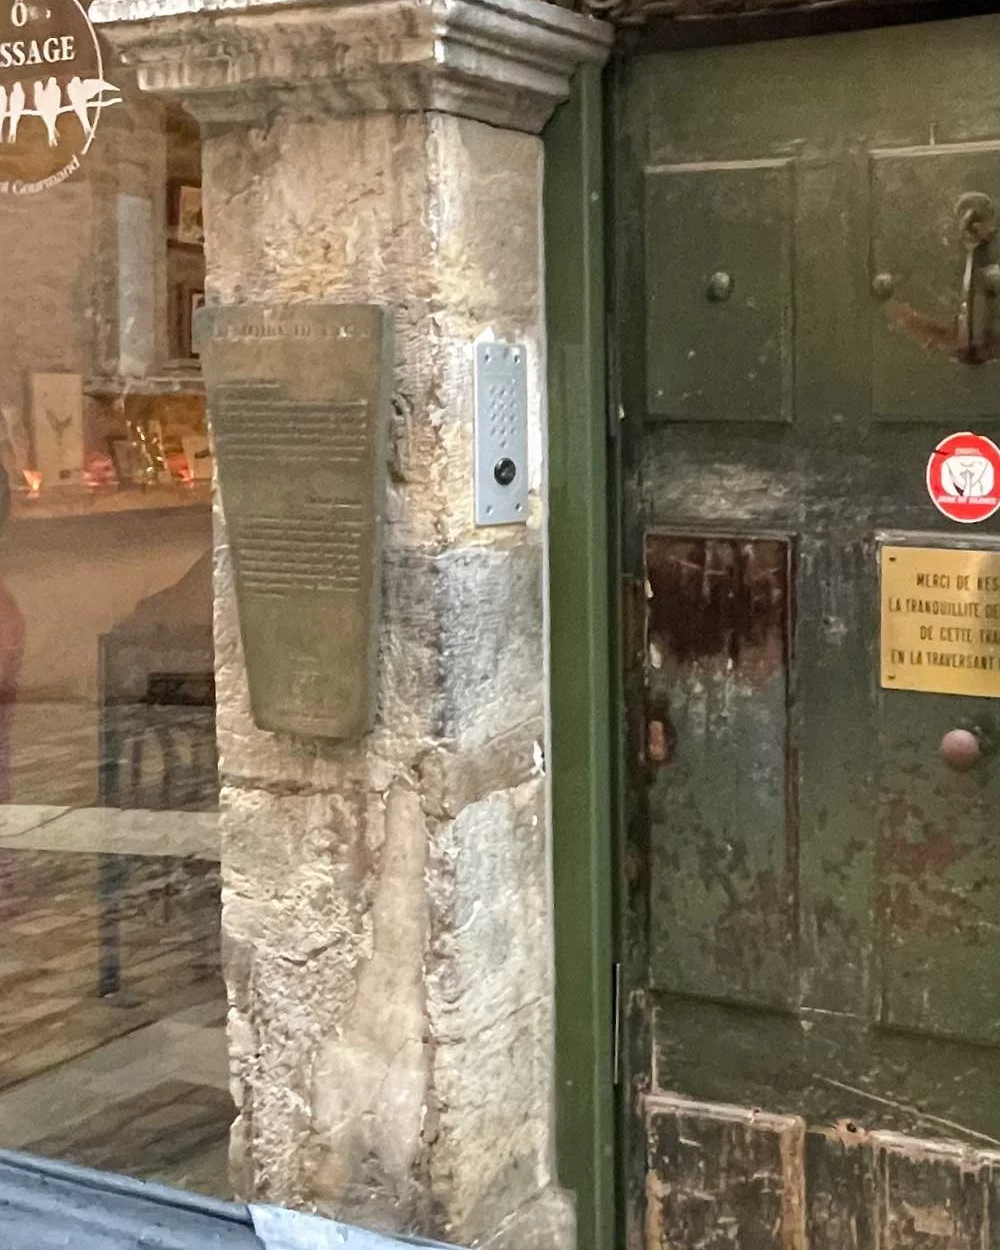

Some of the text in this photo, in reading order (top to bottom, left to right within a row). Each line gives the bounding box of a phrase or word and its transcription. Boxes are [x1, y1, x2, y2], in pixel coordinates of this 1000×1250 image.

[0, 36, 76, 67] SSAGE
[916, 573, 950, 589] MERCI
[956, 575, 970, 591] DE
[888, 598, 901, 612] LA
[920, 625, 933, 641] DE
[940, 626, 973, 643] CETTE
[891, 649, 905, 664] EN
[910, 650, 922, 665] LA
[926, 651, 994, 670] TRAVERSANT
